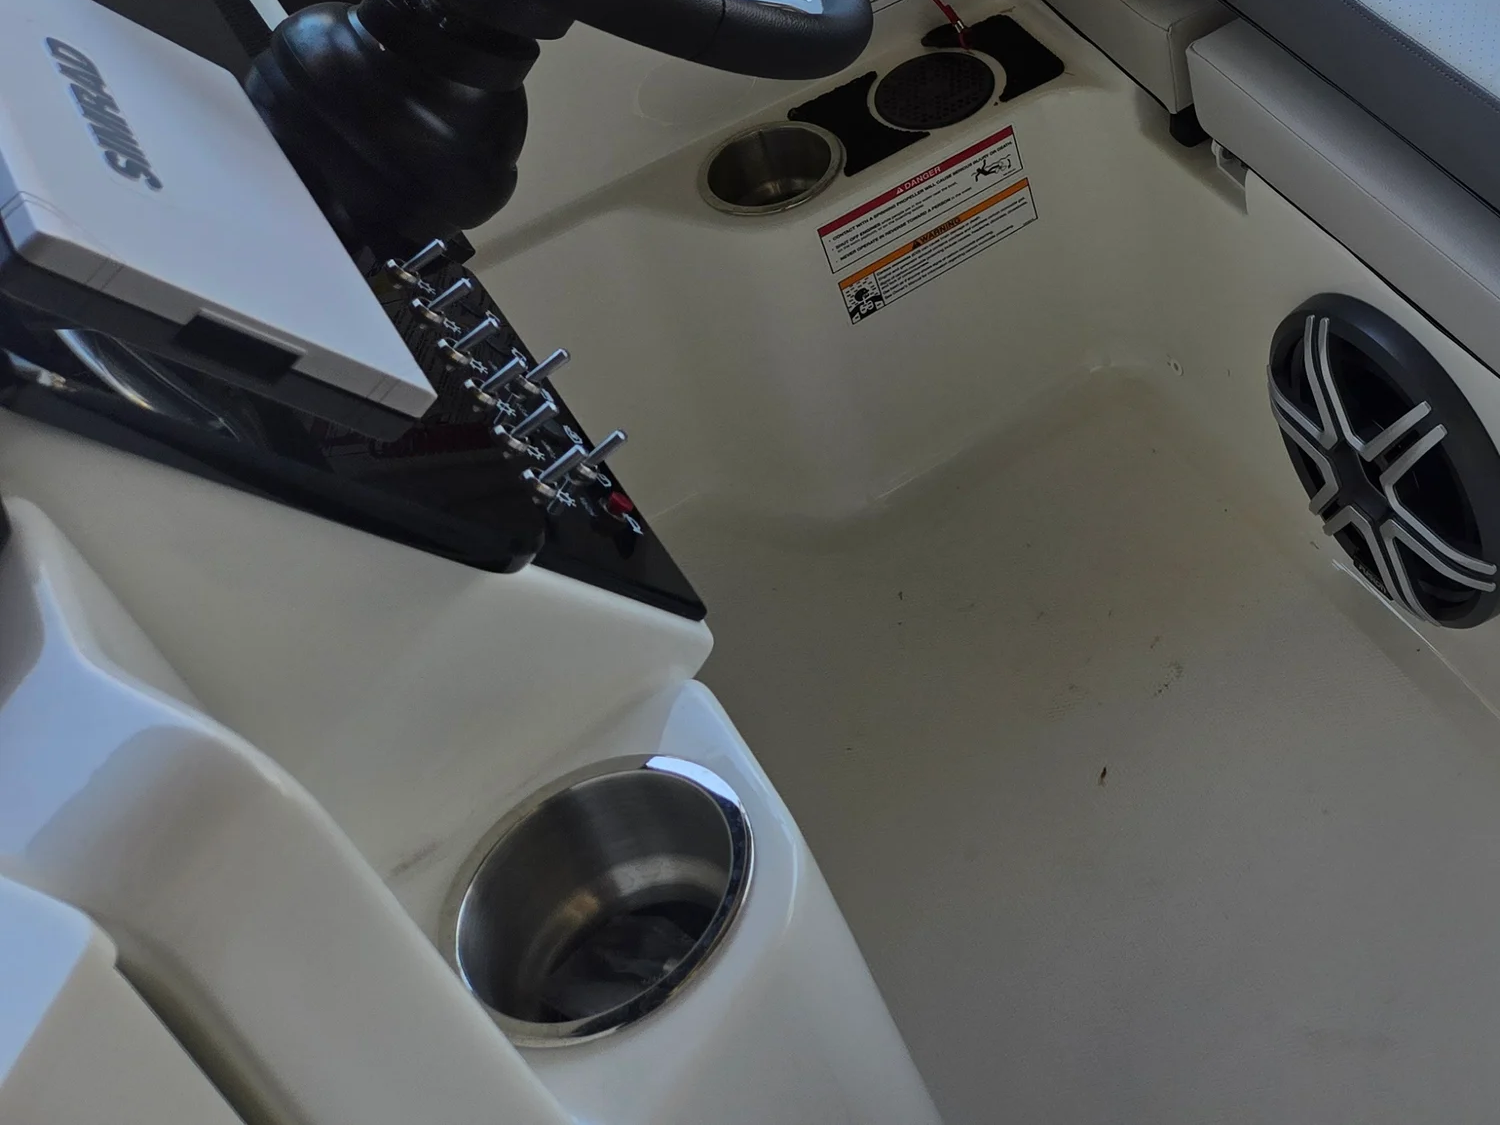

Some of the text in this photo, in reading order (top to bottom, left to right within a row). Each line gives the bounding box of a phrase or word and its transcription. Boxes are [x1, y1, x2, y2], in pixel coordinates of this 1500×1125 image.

[45, 36, 163, 190] SIMRAD
[904, 165, 941, 190] DANGER
[920, 215, 960, 243] WARNING
